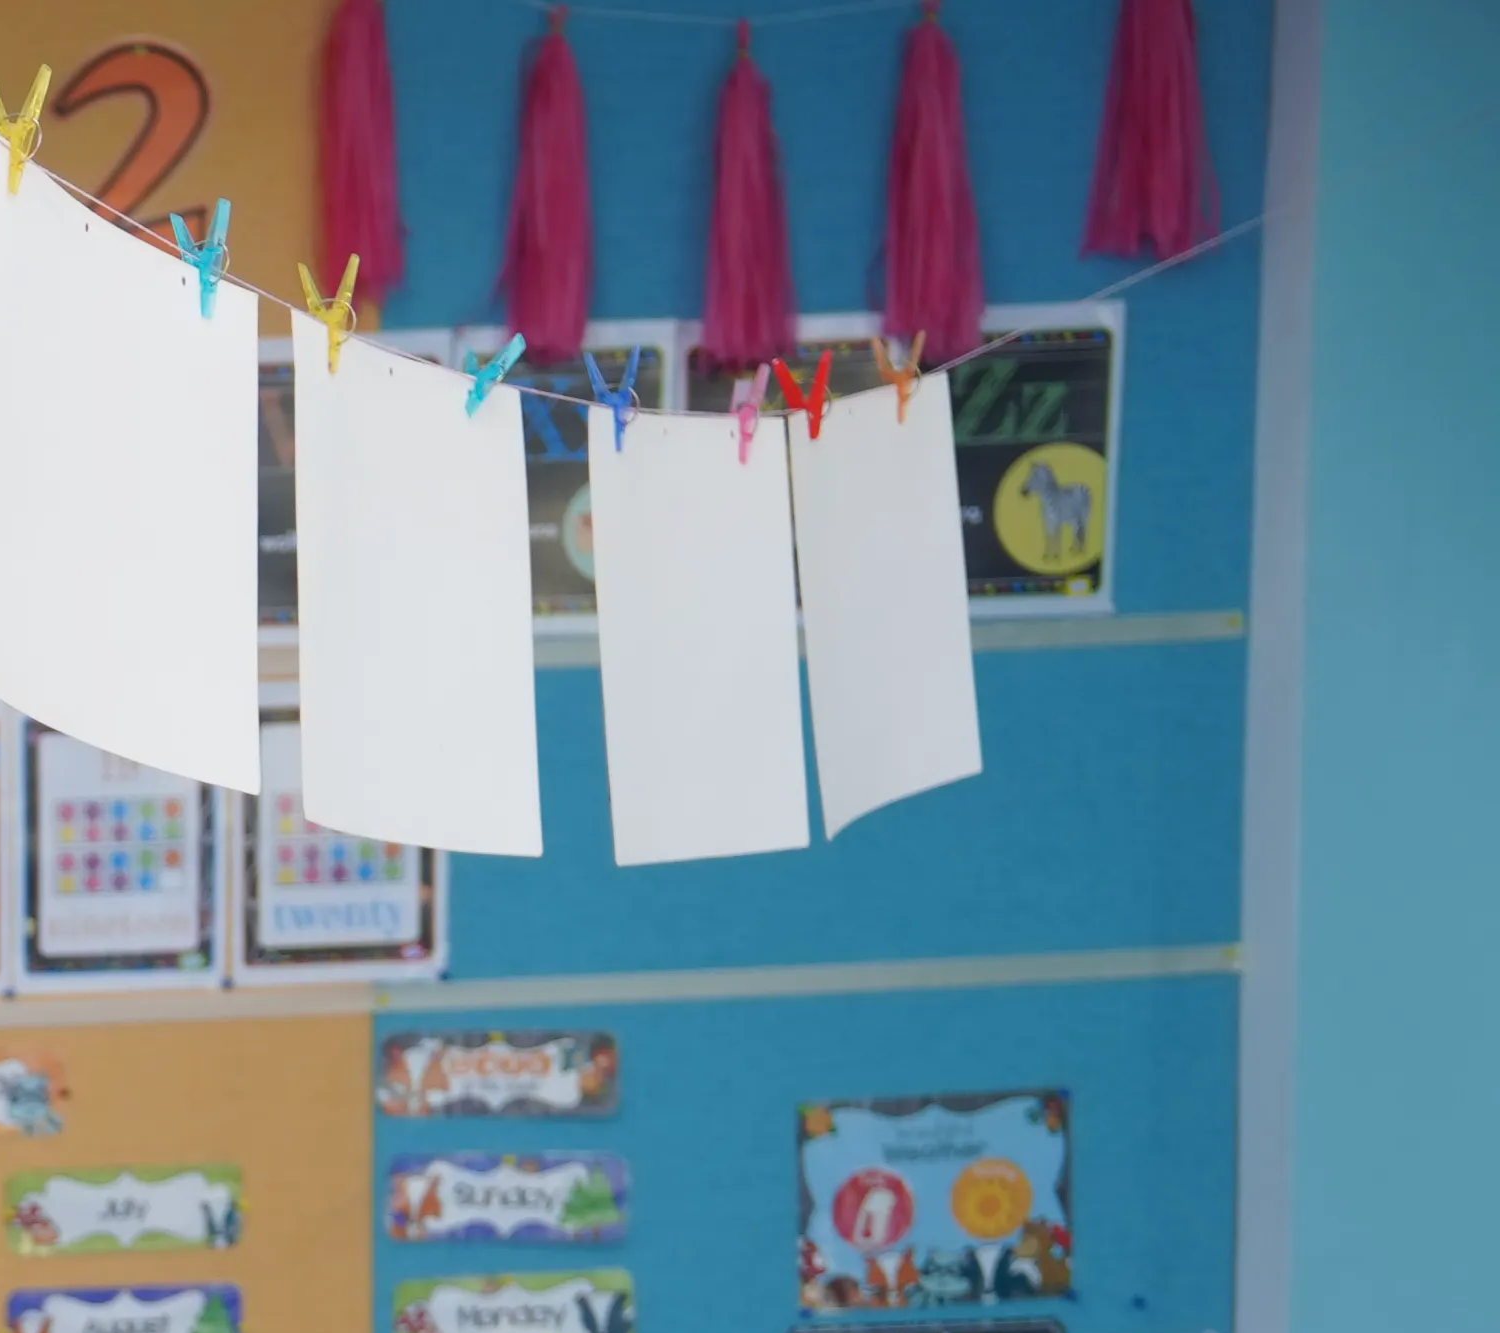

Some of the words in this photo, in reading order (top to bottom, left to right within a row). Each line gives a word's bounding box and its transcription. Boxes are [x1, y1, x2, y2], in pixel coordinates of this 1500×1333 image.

[52, 40, 212, 252] 2
[955, 358, 1069, 445] Zz
[274, 898, 405, 941] twenty
[452, 1181, 556, 1213] Sunday
[456, 1301, 568, 1330] Monday
